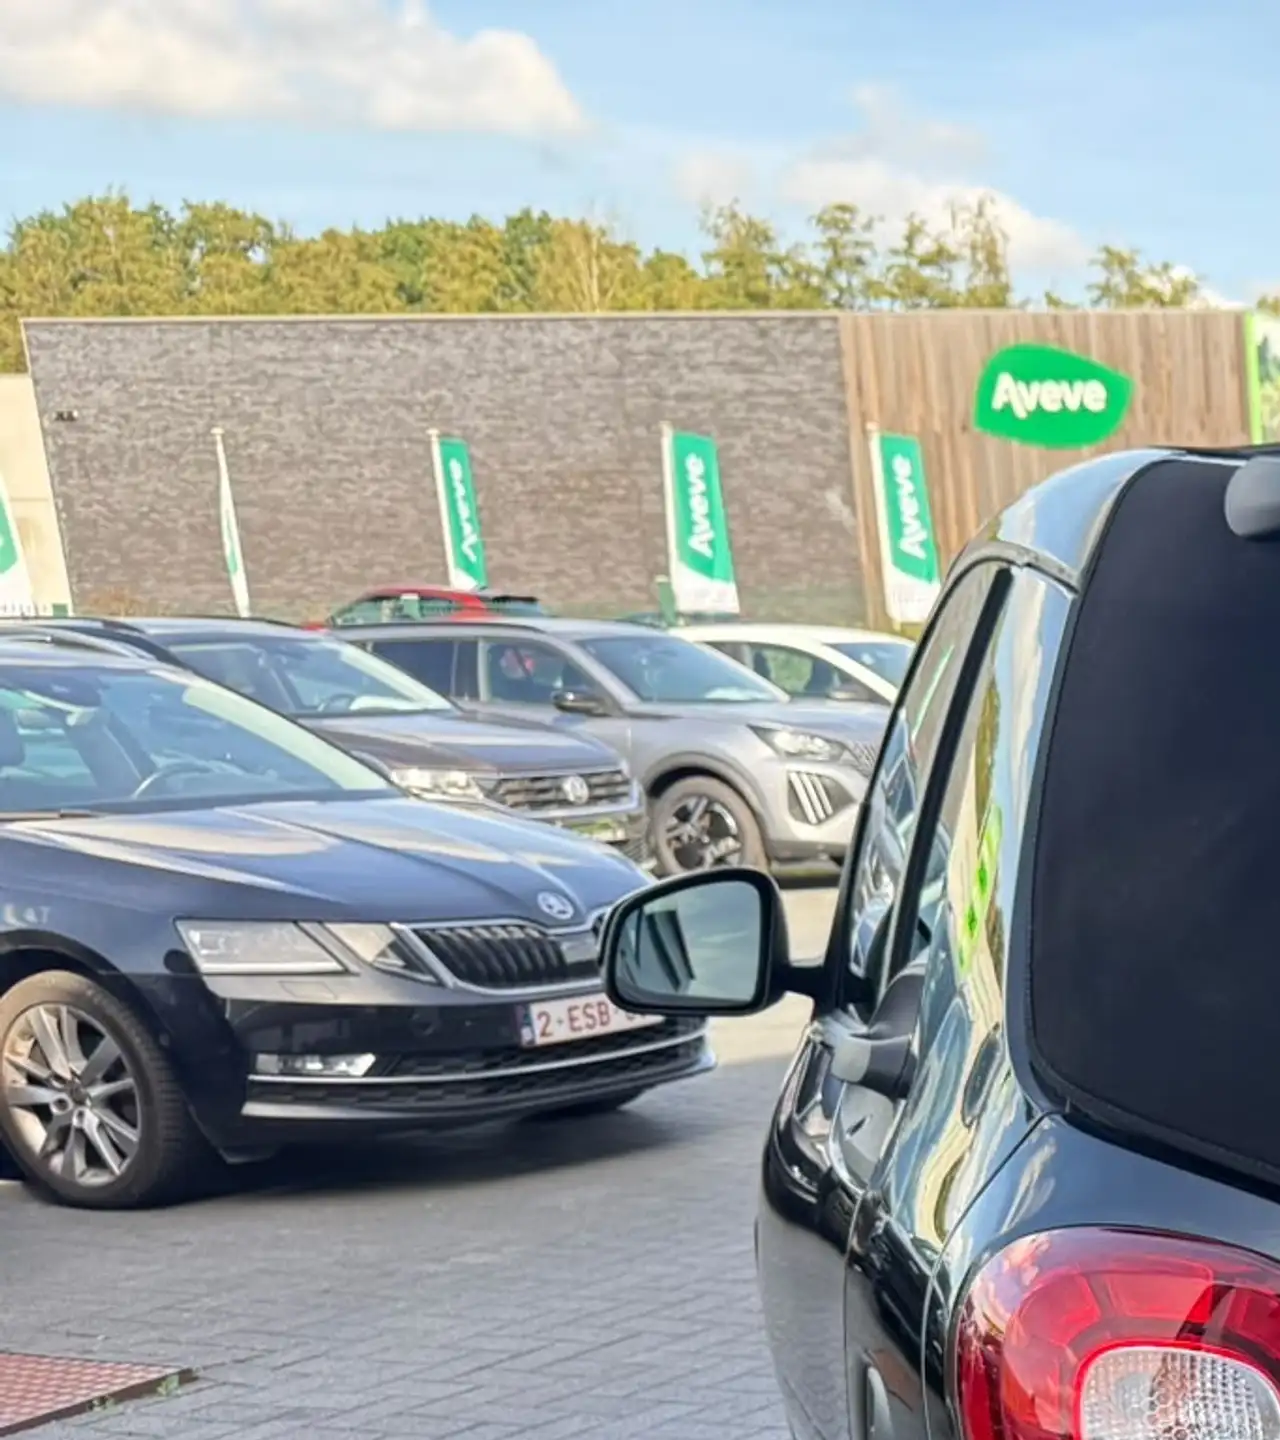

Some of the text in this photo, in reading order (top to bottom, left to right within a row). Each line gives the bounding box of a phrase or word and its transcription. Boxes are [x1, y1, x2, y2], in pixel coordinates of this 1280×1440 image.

[991, 371, 1107, 420] Aveve
[684, 452, 715, 559] Aveve
[892, 453, 928, 560] Aveve
